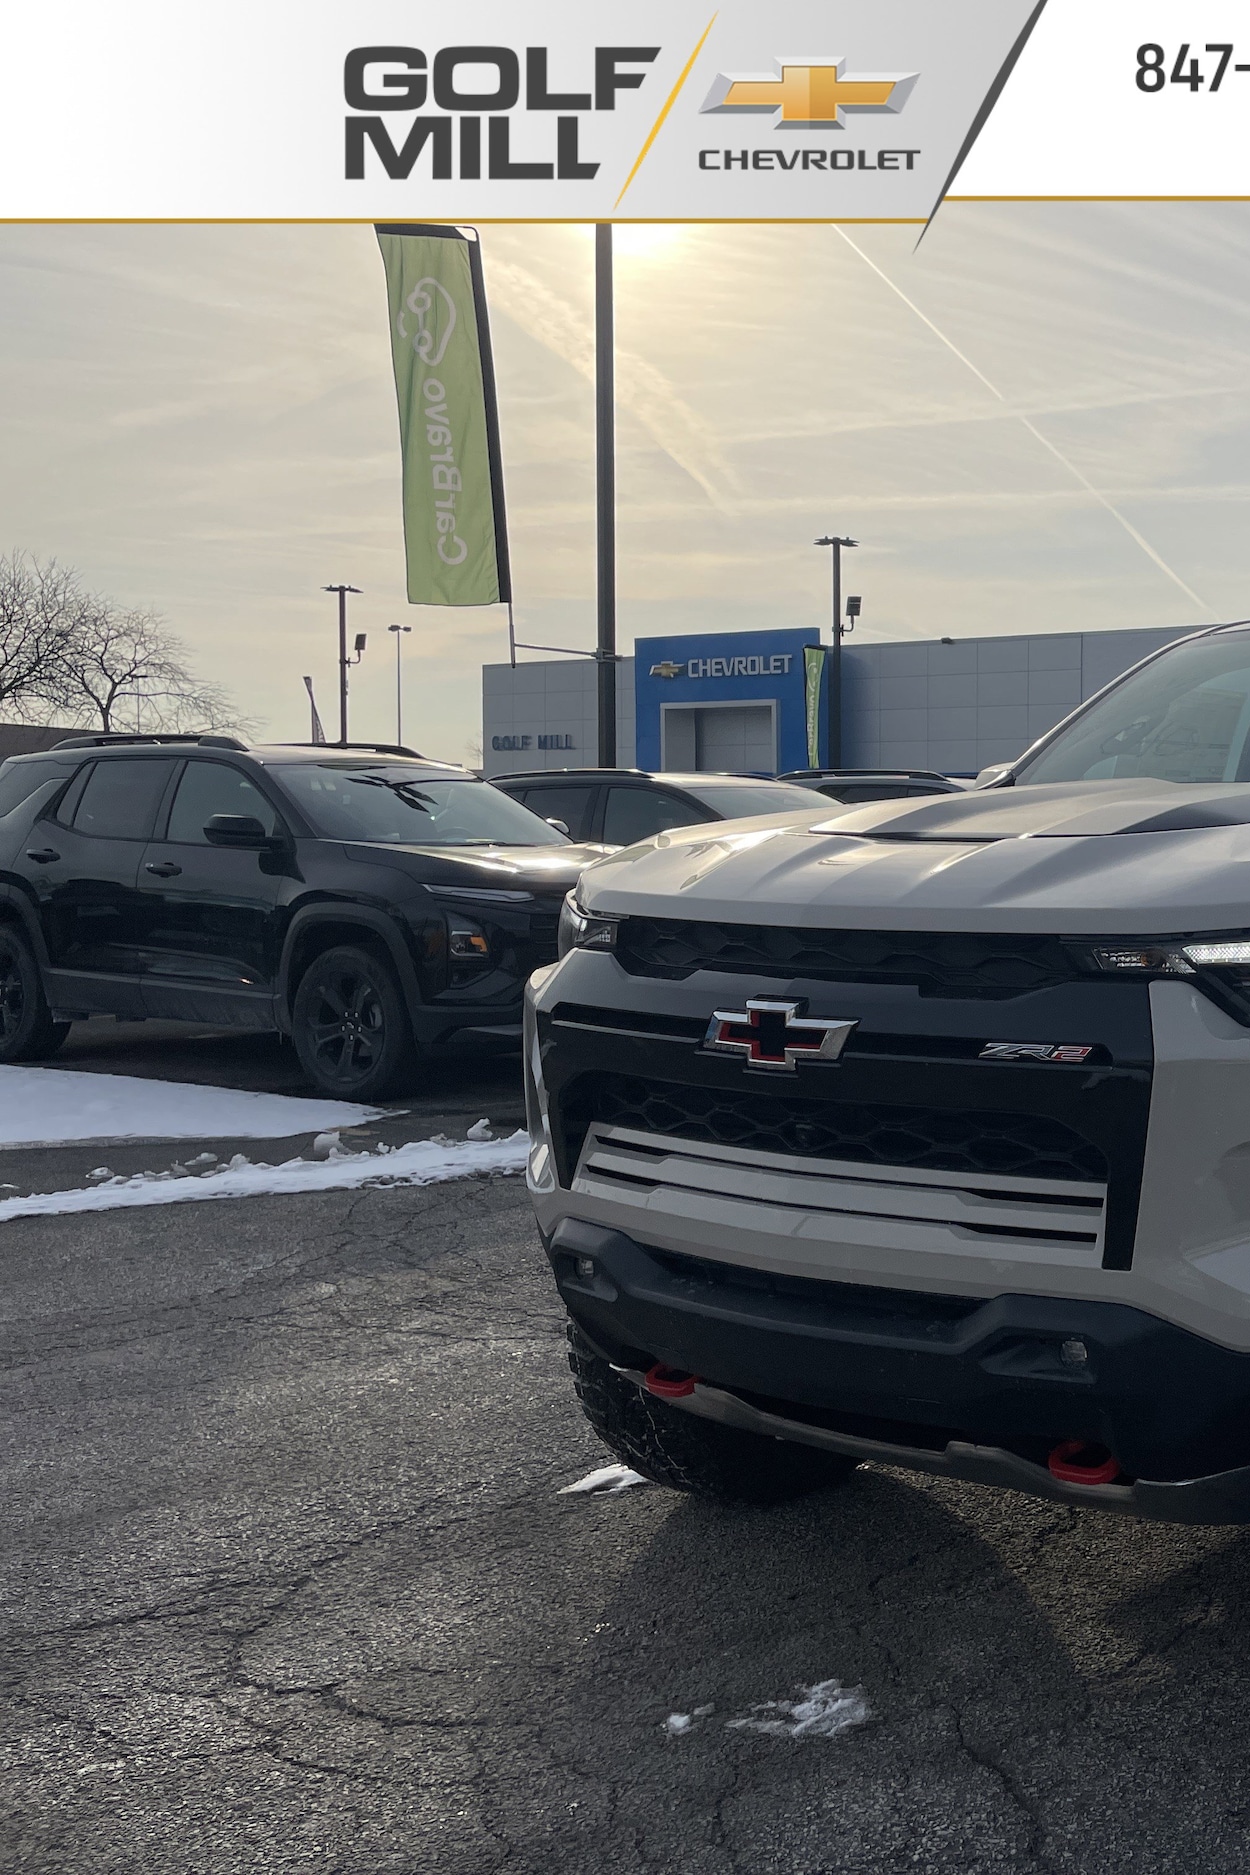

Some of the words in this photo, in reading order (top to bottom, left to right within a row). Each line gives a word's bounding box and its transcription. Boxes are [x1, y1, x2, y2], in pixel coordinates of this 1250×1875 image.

[687, 654, 793, 678] CHEVROLET
[492, 735, 532, 751] GOLF
[537, 734, 576, 750] MILL
[978, 1042, 1093, 1062] ZR2
